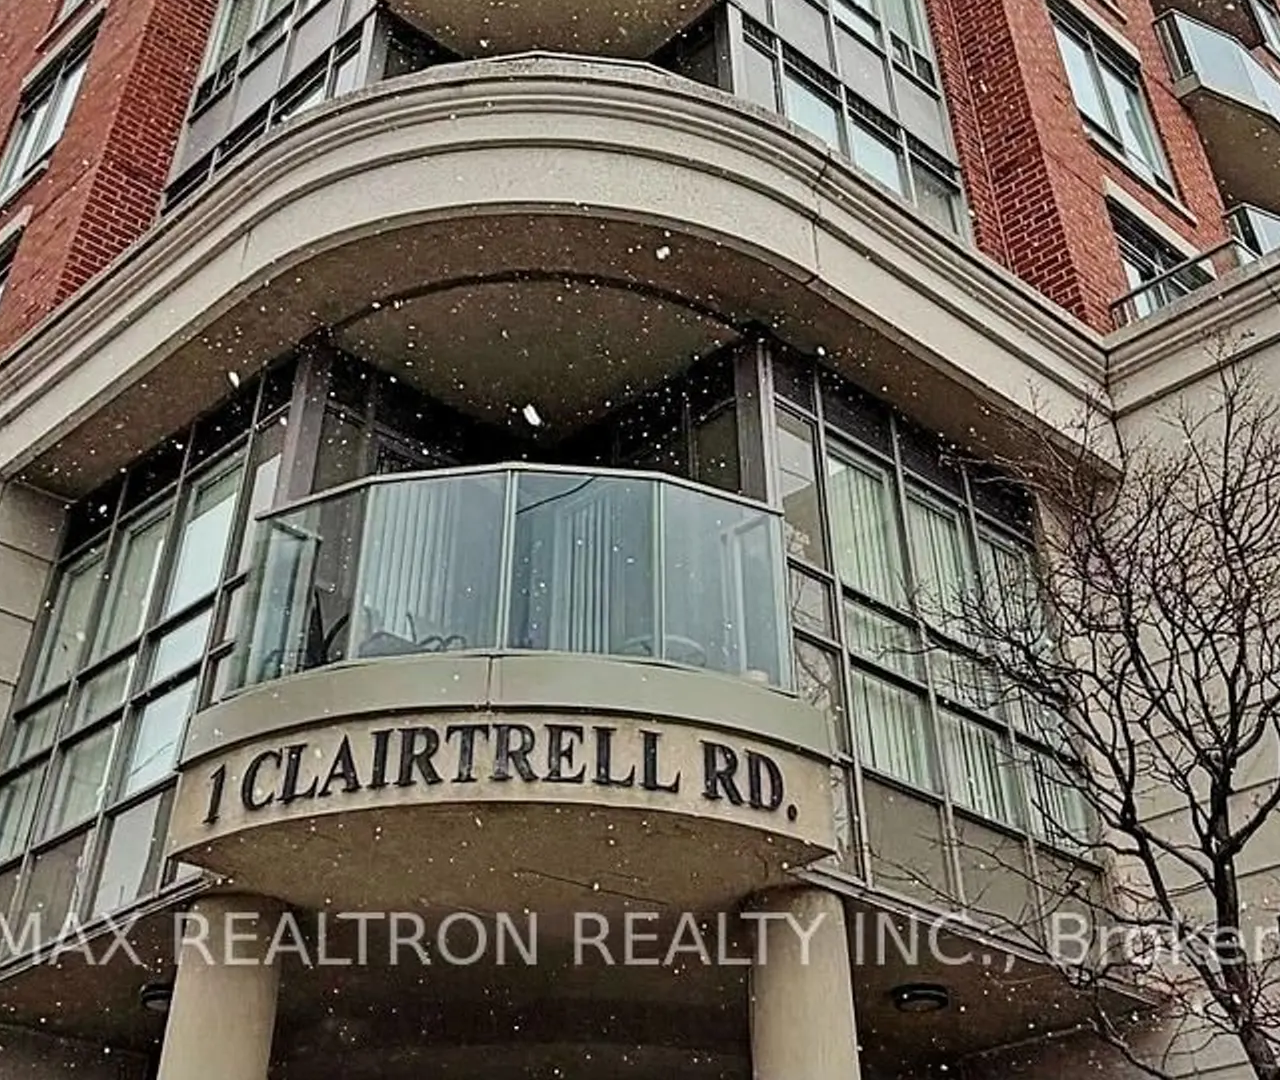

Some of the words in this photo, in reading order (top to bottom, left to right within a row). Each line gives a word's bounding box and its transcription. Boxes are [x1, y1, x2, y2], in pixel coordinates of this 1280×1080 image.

[202, 763, 227, 824] 1
[240, 723, 681, 811] CLAIRTRELL
[699, 738, 798, 822] RD.
